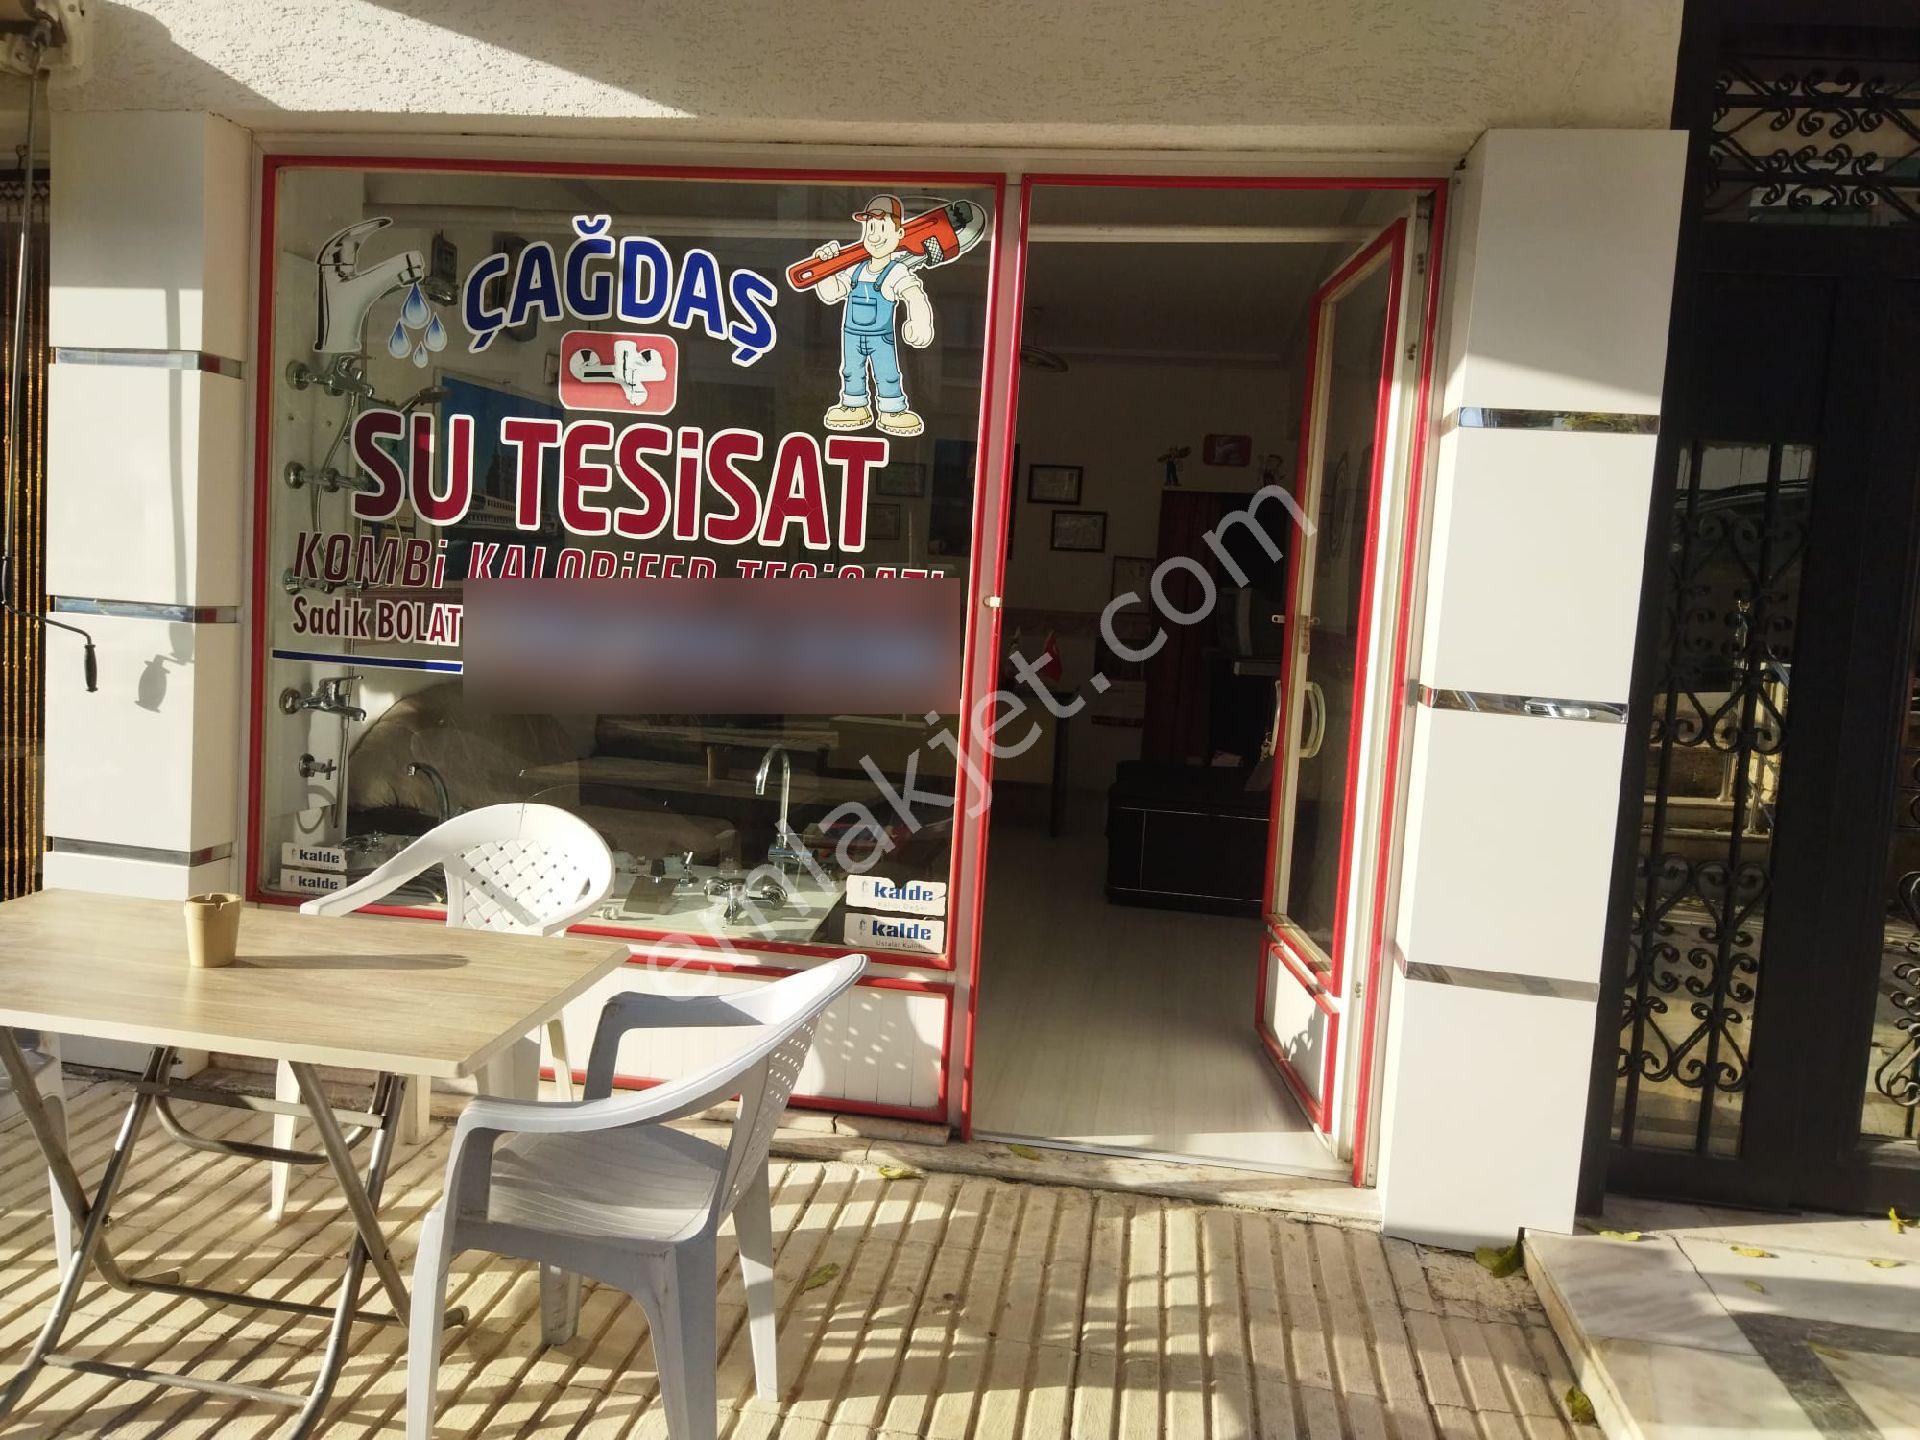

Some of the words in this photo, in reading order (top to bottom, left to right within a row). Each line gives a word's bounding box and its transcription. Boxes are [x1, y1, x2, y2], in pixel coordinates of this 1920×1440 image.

[462, 214, 778, 368] ÇAĞDAŞ
[351, 408, 475, 526] SU
[375, 598, 464, 647] BOLAT
[299, 849, 340, 864] kalde
[298, 875, 339, 890] kalde
[874, 881, 934, 901] kalde
[872, 919, 932, 940] kalde
